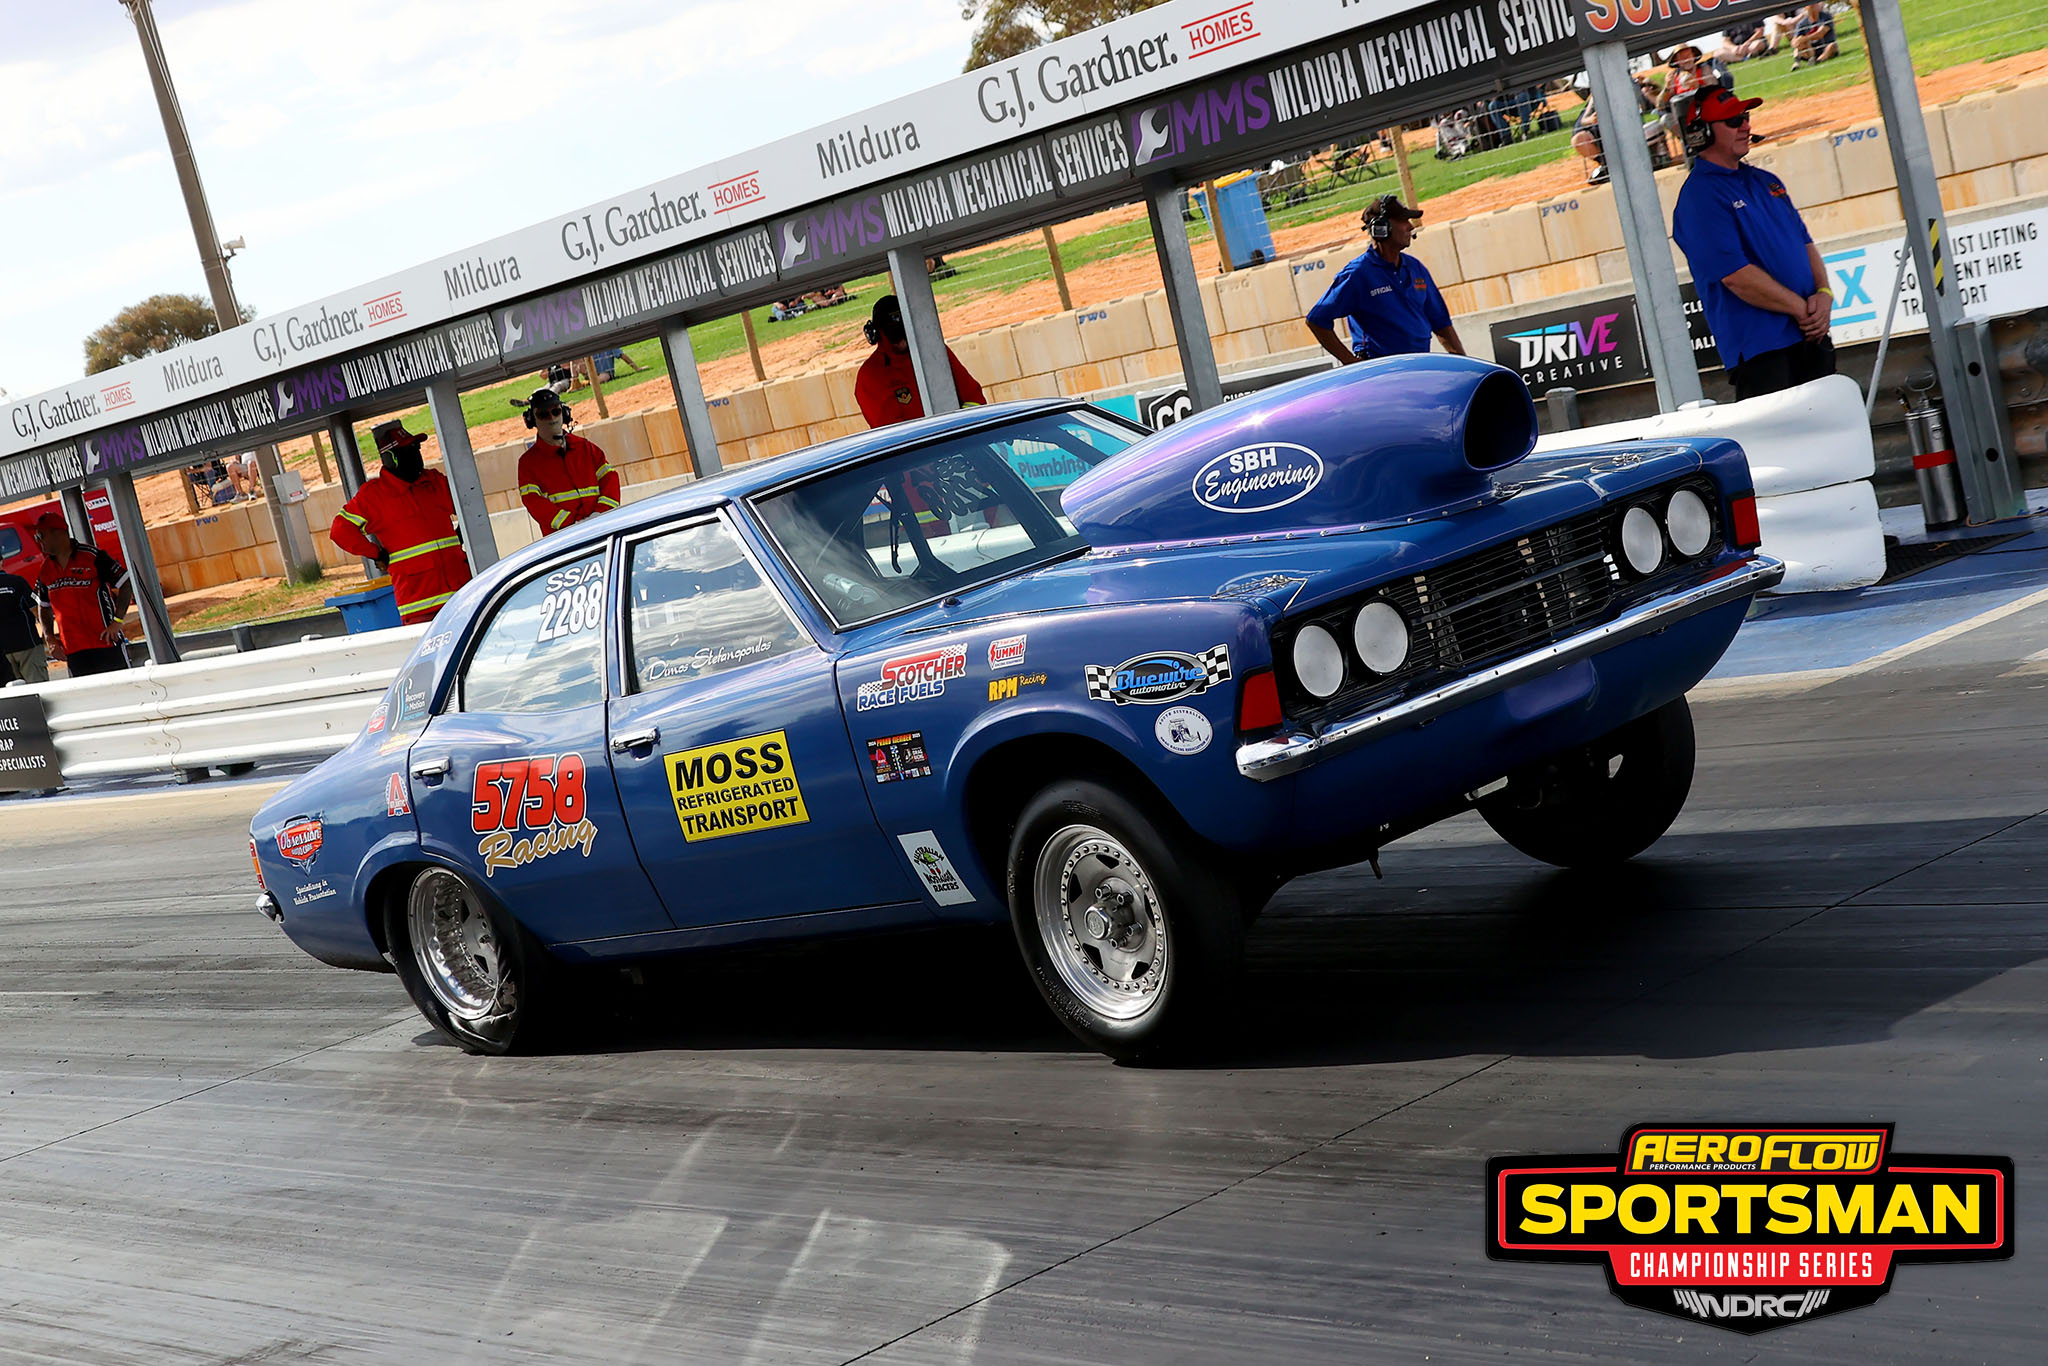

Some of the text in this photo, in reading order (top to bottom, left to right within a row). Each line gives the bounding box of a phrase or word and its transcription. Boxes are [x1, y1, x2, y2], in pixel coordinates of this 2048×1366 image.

[978, 11, 1254, 128] G.J. Gardner. HOMES
[1174, 74, 1271, 153] MMS
[1268, 47, 1362, 123] MILDURA
[1359, 5, 1497, 95] MECHANICAL
[816, 121, 921, 179] Mildura
[1834, 127, 1880, 146] FWG
[807, 119, 1130, 260] MMS MILDURA MECHANICAL SERVICES
[1542, 199, 1579, 217] FWG
[561, 178, 760, 265] G.J. Gardner. HOMES
[1980, 222, 2037, 251] LIFTING
[444, 255, 522, 300] Mildura
[1987, 251, 2023, 276] HIRE
[523, 229, 777, 346] MMS MILDURA MECHANICAL SERVICES
[253, 297, 404, 366] G.J. Gardner. HOMES
[1502, 312, 1620, 370] DRIVE
[162, 355, 224, 393] Mildura
[295, 316, 499, 413] MMS MILDURA MECHANICAL SERVICES
[1521, 355, 1624, 386] CREATIVE
[12, 386, 133, 442] G.J. Gardner. HOMES
[100, 388, 276, 469] MMS MILDURA MECHANICAL SERVICES
[47, 445, 84, 485] SERVICES
[1018, 453, 1086, 479] Plumbing
[1229, 447, 1278, 474] SBH
[1204, 464, 1316, 504] Engineering
[546, 561, 604, 593] SS/A
[537, 580, 604, 643] 2288
[882, 651, 966, 689] SCOTCHER
[990, 642, 1024, 662] SUMMIT
[859, 680, 944, 710] RACE FUELS
[989, 677, 1018, 701] RPM
[1019, 673, 1047, 686] Racing
[1111, 660, 1209, 692] Bluewire
[1130, 681, 1187, 696] automotive
[0, 755, 47, 771] SPECIALISTS
[675, 741, 784, 792] MOSS
[472, 752, 587, 834] 5758
[676, 777, 794, 811] REFRIGERATED
[683, 796, 798, 834] TRANSPORT
[280, 828, 321, 850] Obsession
[478, 818, 598, 877] Racing
[933, 882, 959, 892] RACERS
